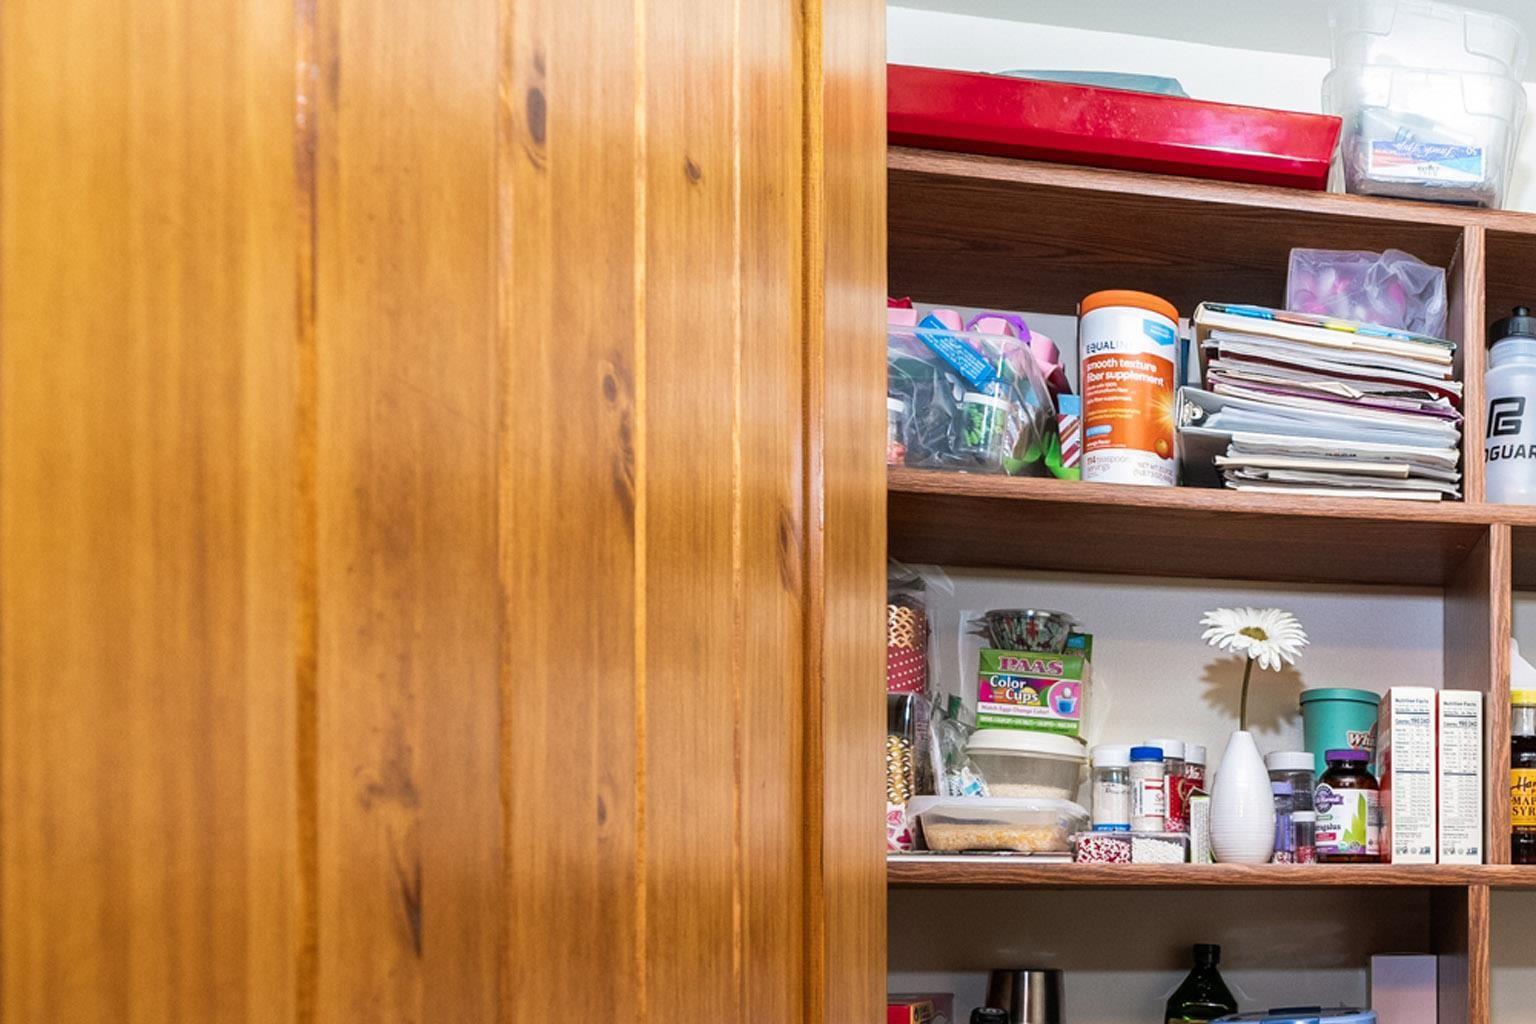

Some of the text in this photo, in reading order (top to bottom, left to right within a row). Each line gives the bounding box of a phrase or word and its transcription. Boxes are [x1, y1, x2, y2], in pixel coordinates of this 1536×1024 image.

[1105, 370, 1164, 388] supplement
[998, 655, 1064, 676] PAAS
[990, 674, 1027, 689] Color
[1005, 688, 1038, 704] Cups
